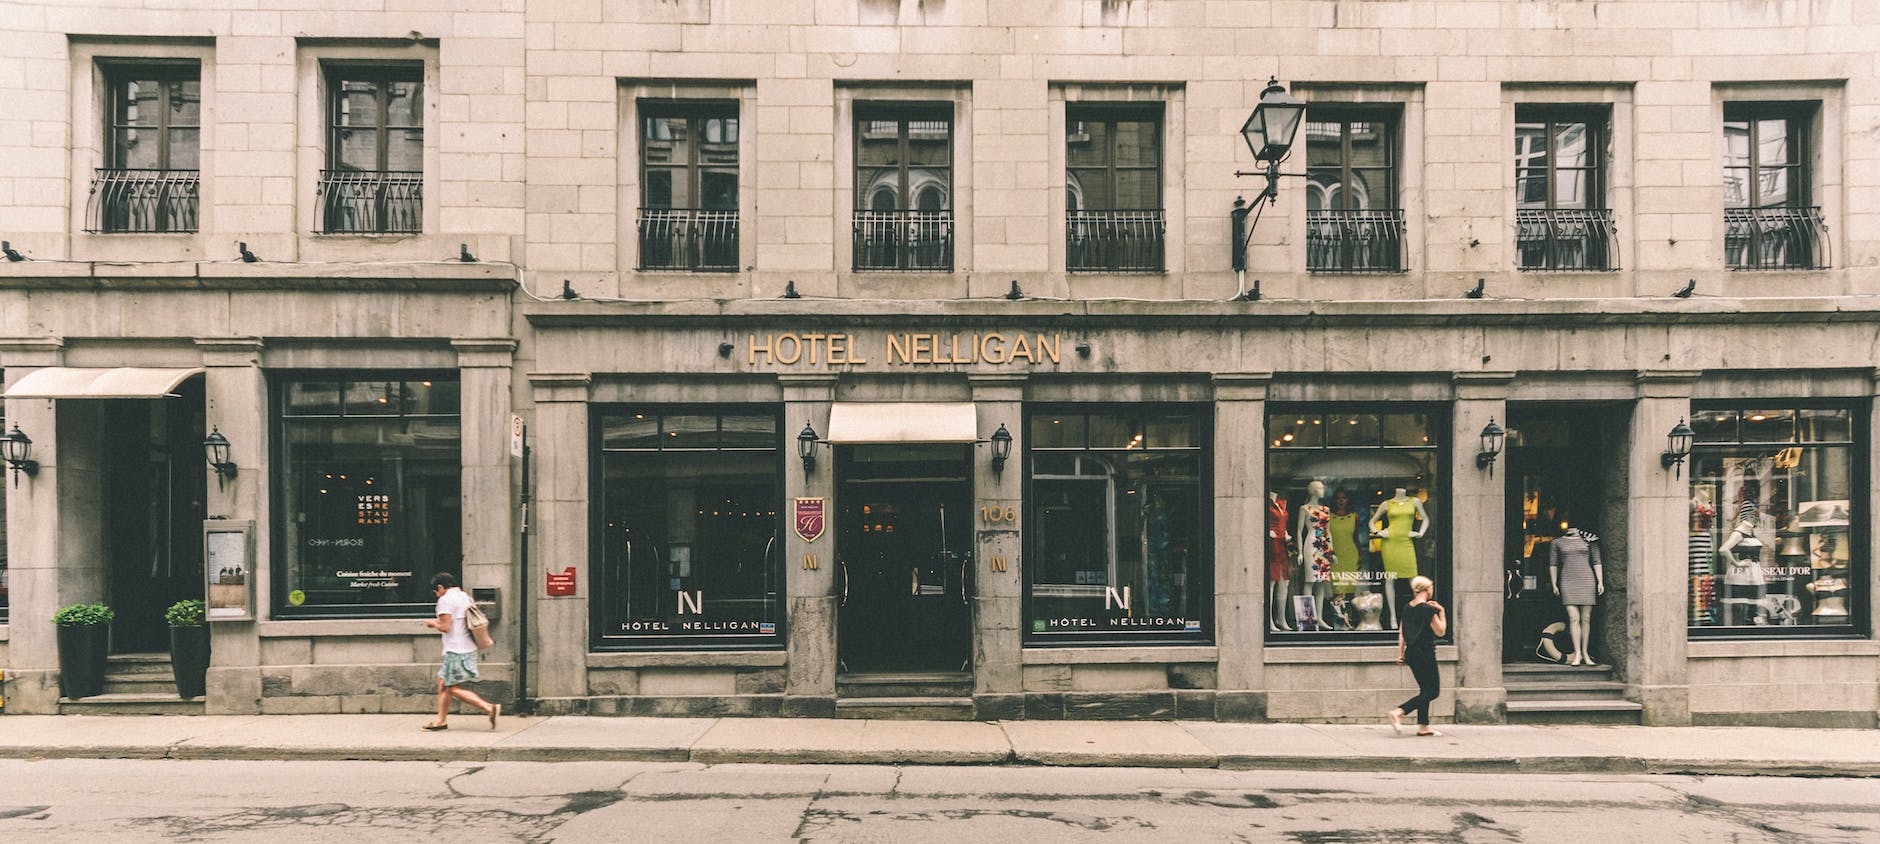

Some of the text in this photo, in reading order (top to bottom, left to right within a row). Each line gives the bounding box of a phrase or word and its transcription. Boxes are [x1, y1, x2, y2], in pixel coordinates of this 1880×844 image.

[749, 333, 1061, 365] HOTEL NELLIGAN
[981, 505, 1016, 522] 106
[1317, 571, 1398, 580] LE VAISSEAU D'OR
[1732, 566, 1811, 576] LE VSSEAU D'OR
[683, 621, 759, 630] NELLIGAN
[1050, 617, 1096, 627] HÔTEL
[1110, 617, 1185, 626] NELLIGAN
